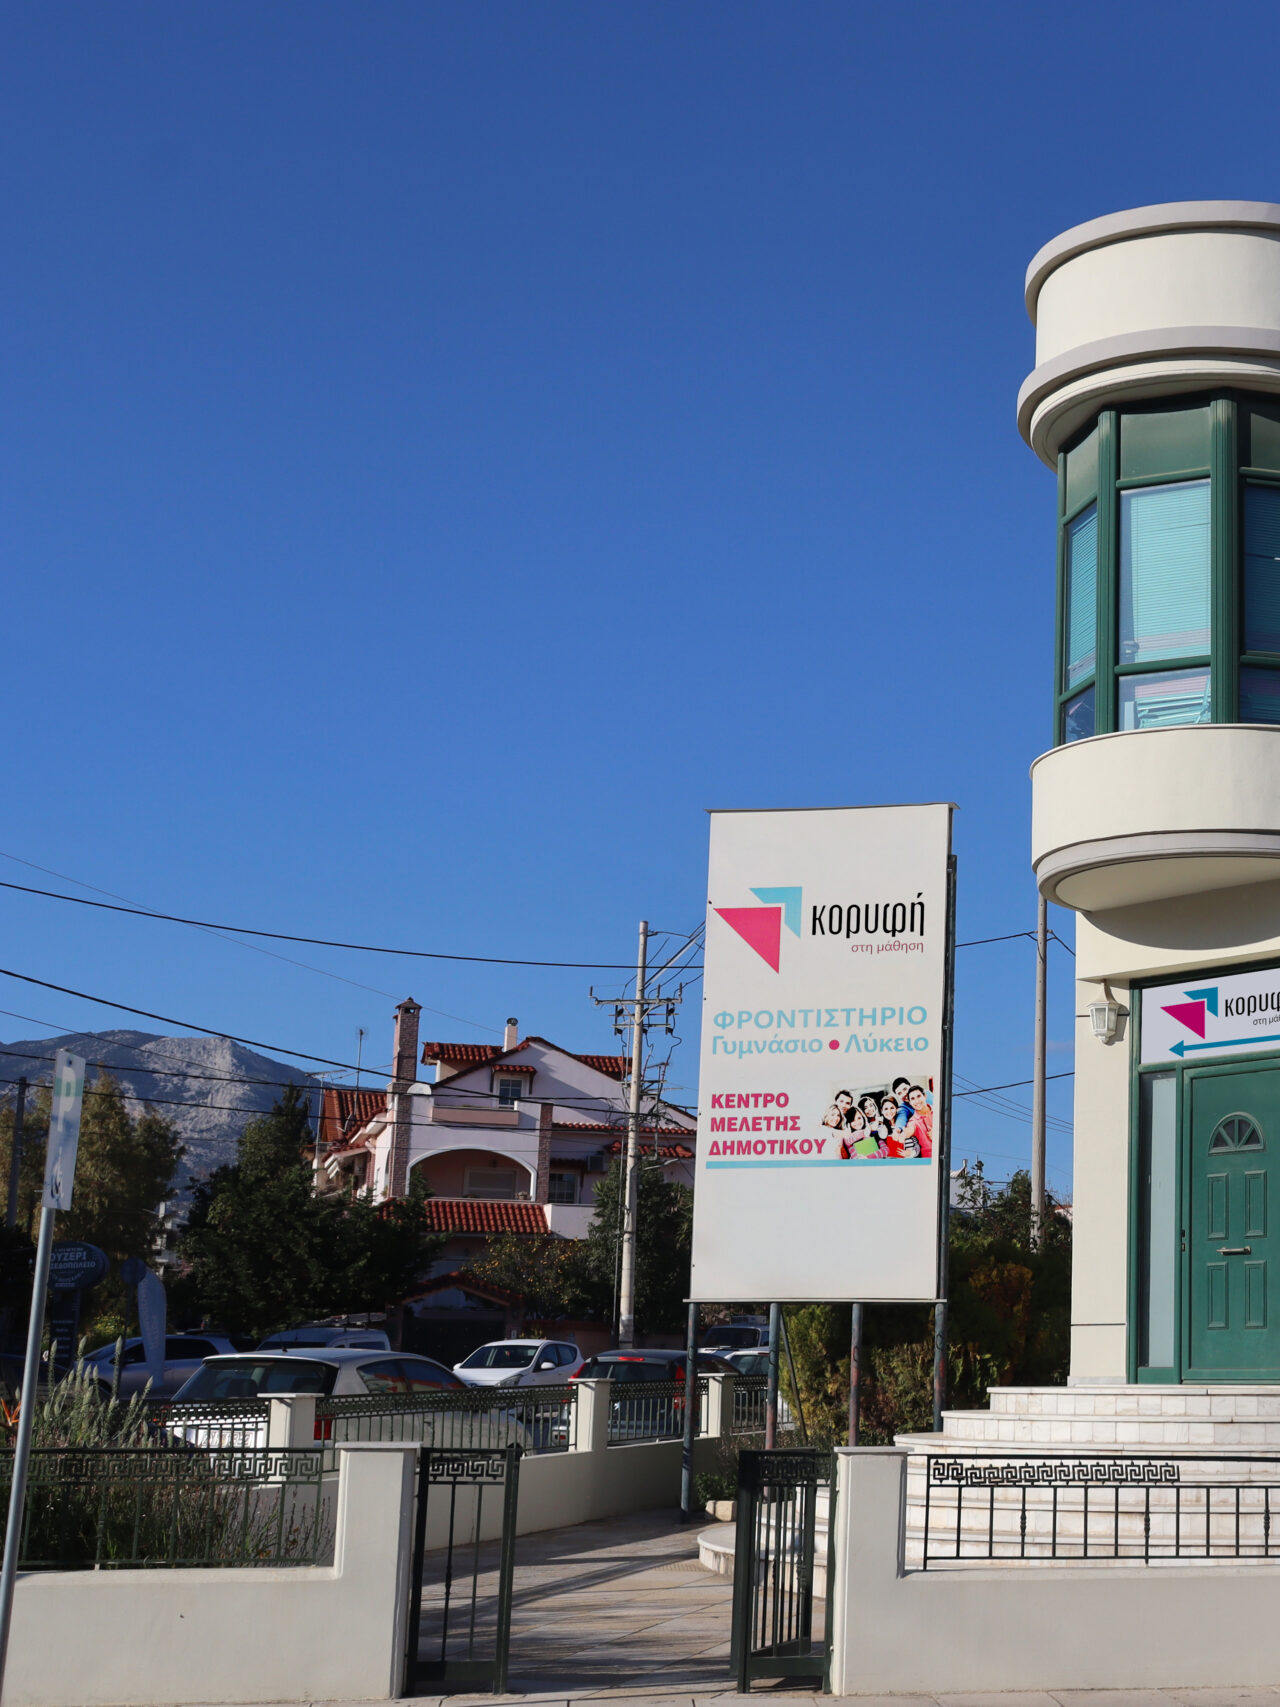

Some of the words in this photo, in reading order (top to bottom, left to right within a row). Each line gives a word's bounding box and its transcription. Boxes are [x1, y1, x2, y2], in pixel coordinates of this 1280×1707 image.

[811, 892, 925, 939] κορυφή
[851, 942, 873, 955] στη
[877, 940, 924, 954] μάθηση
[713, 1006, 928, 1030] ΦΡΟΝΤΙΣΤΗΡΙΟ
[1253, 1016, 1267, 1026] στη
[712, 1034, 823, 1059] Γυμνάσιο
[844, 1032, 929, 1053] Λύκειο
[711, 1092, 789, 1109] ΚΕΝΤΡΟ
[710, 1115, 801, 1132] ΜΕΛΕΤΗΣ
[709, 1139, 826, 1156] ΔΗΜΟΤΙΚΟΥ
